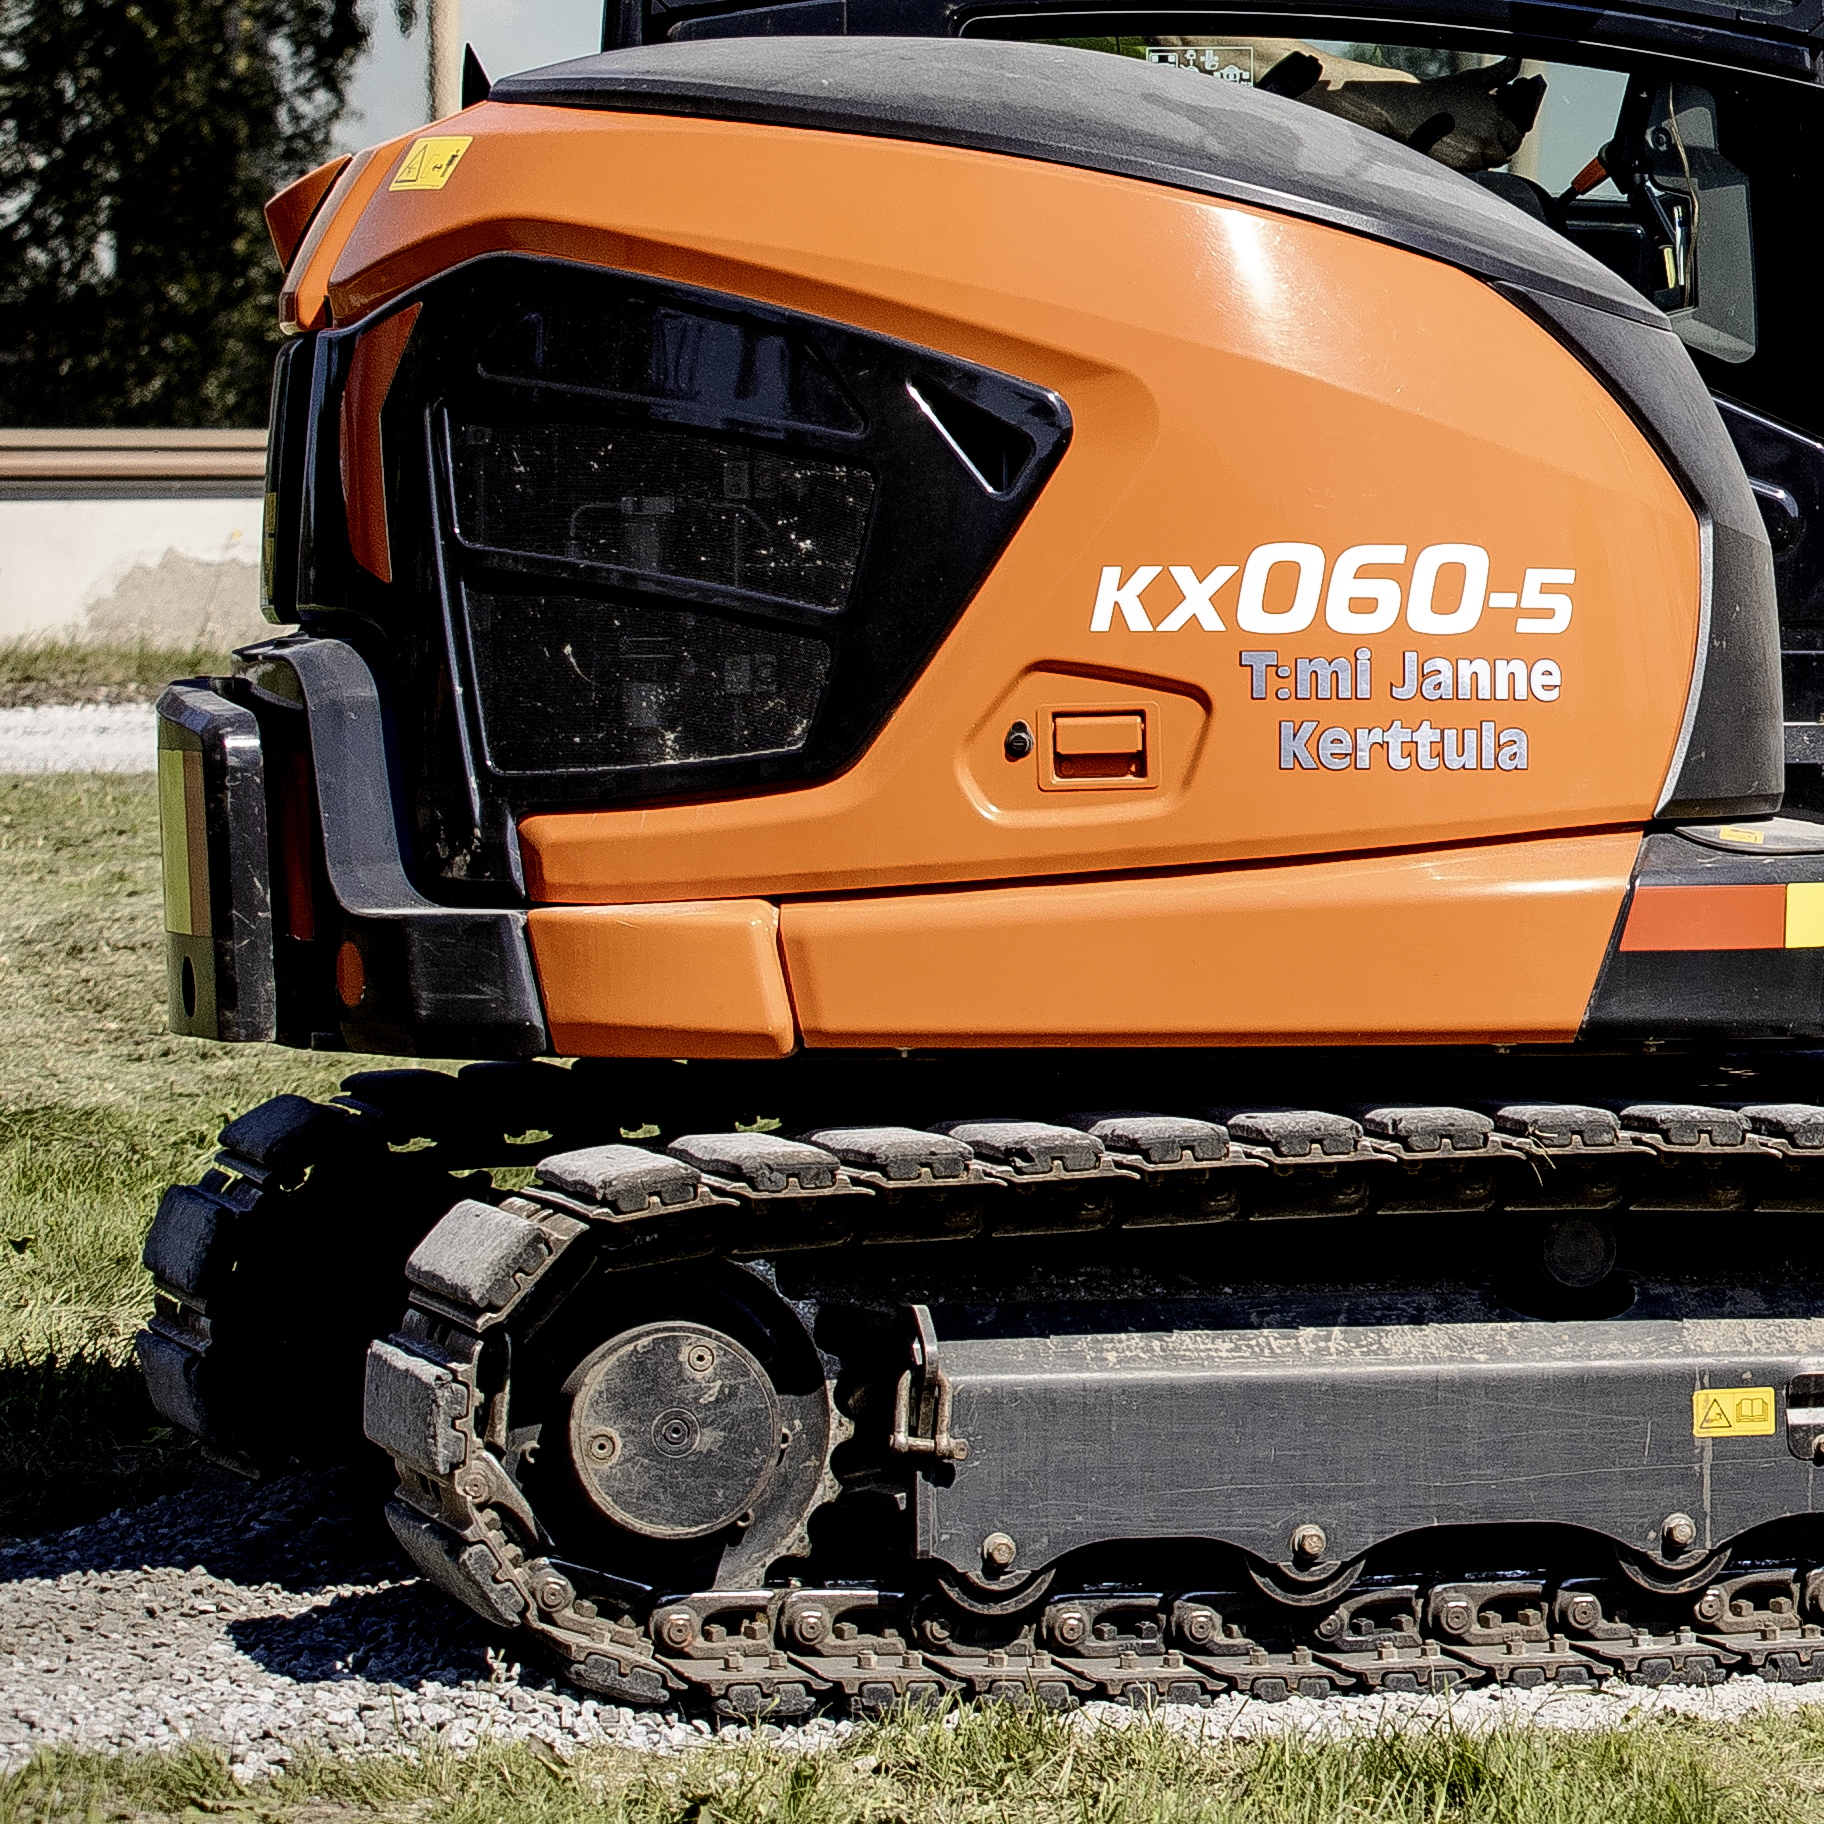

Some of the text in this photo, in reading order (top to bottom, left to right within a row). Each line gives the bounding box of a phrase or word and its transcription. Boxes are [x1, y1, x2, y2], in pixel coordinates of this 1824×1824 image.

[1090, 541, 1577, 635] KX060-5
[1239, 647, 1563, 702] T:mi Janne
[1278, 720, 1529, 772] Kerttula
